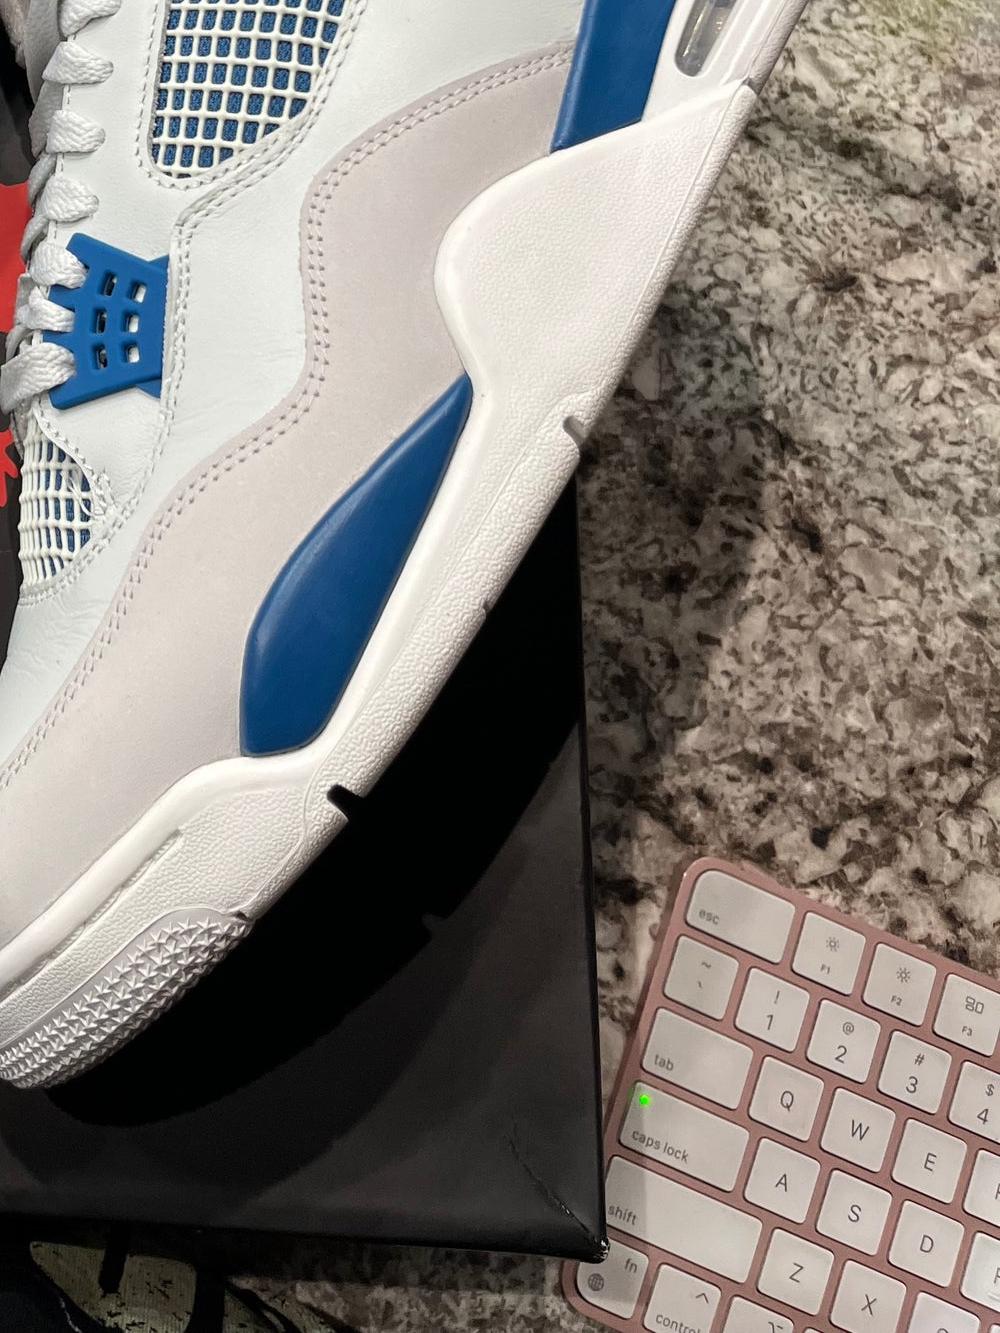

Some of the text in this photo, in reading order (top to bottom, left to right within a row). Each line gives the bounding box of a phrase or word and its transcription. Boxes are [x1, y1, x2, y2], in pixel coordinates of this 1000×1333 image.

[698, 909, 720, 925] esc
[820, 964, 831, 975] F1
[890, 994, 903, 1006] F2
[766, 1014, 774, 1031] 1
[961, 1025, 974, 1037] F3
[654, 1054, 675, 1072] tab
[834, 1045, 848, 1064] 2
[905, 1076, 919, 1094] 3
[780, 1090, 795, 1112] Q
[976, 1108, 990, 1125] 4
[850, 1119, 870, 1141] W
[631, 1129, 690, 1165] caps lock
[923, 1152, 938, 1172] E
[774, 1173, 788, 1192] A
[607, 1204, 638, 1227] shift
[847, 1204, 862, 1223] S
[919, 1234, 934, 1253] D
[624, 1258, 640, 1274] fn
[789, 1262, 805, 1283] Z
[860, 1293, 878, 1316] X
